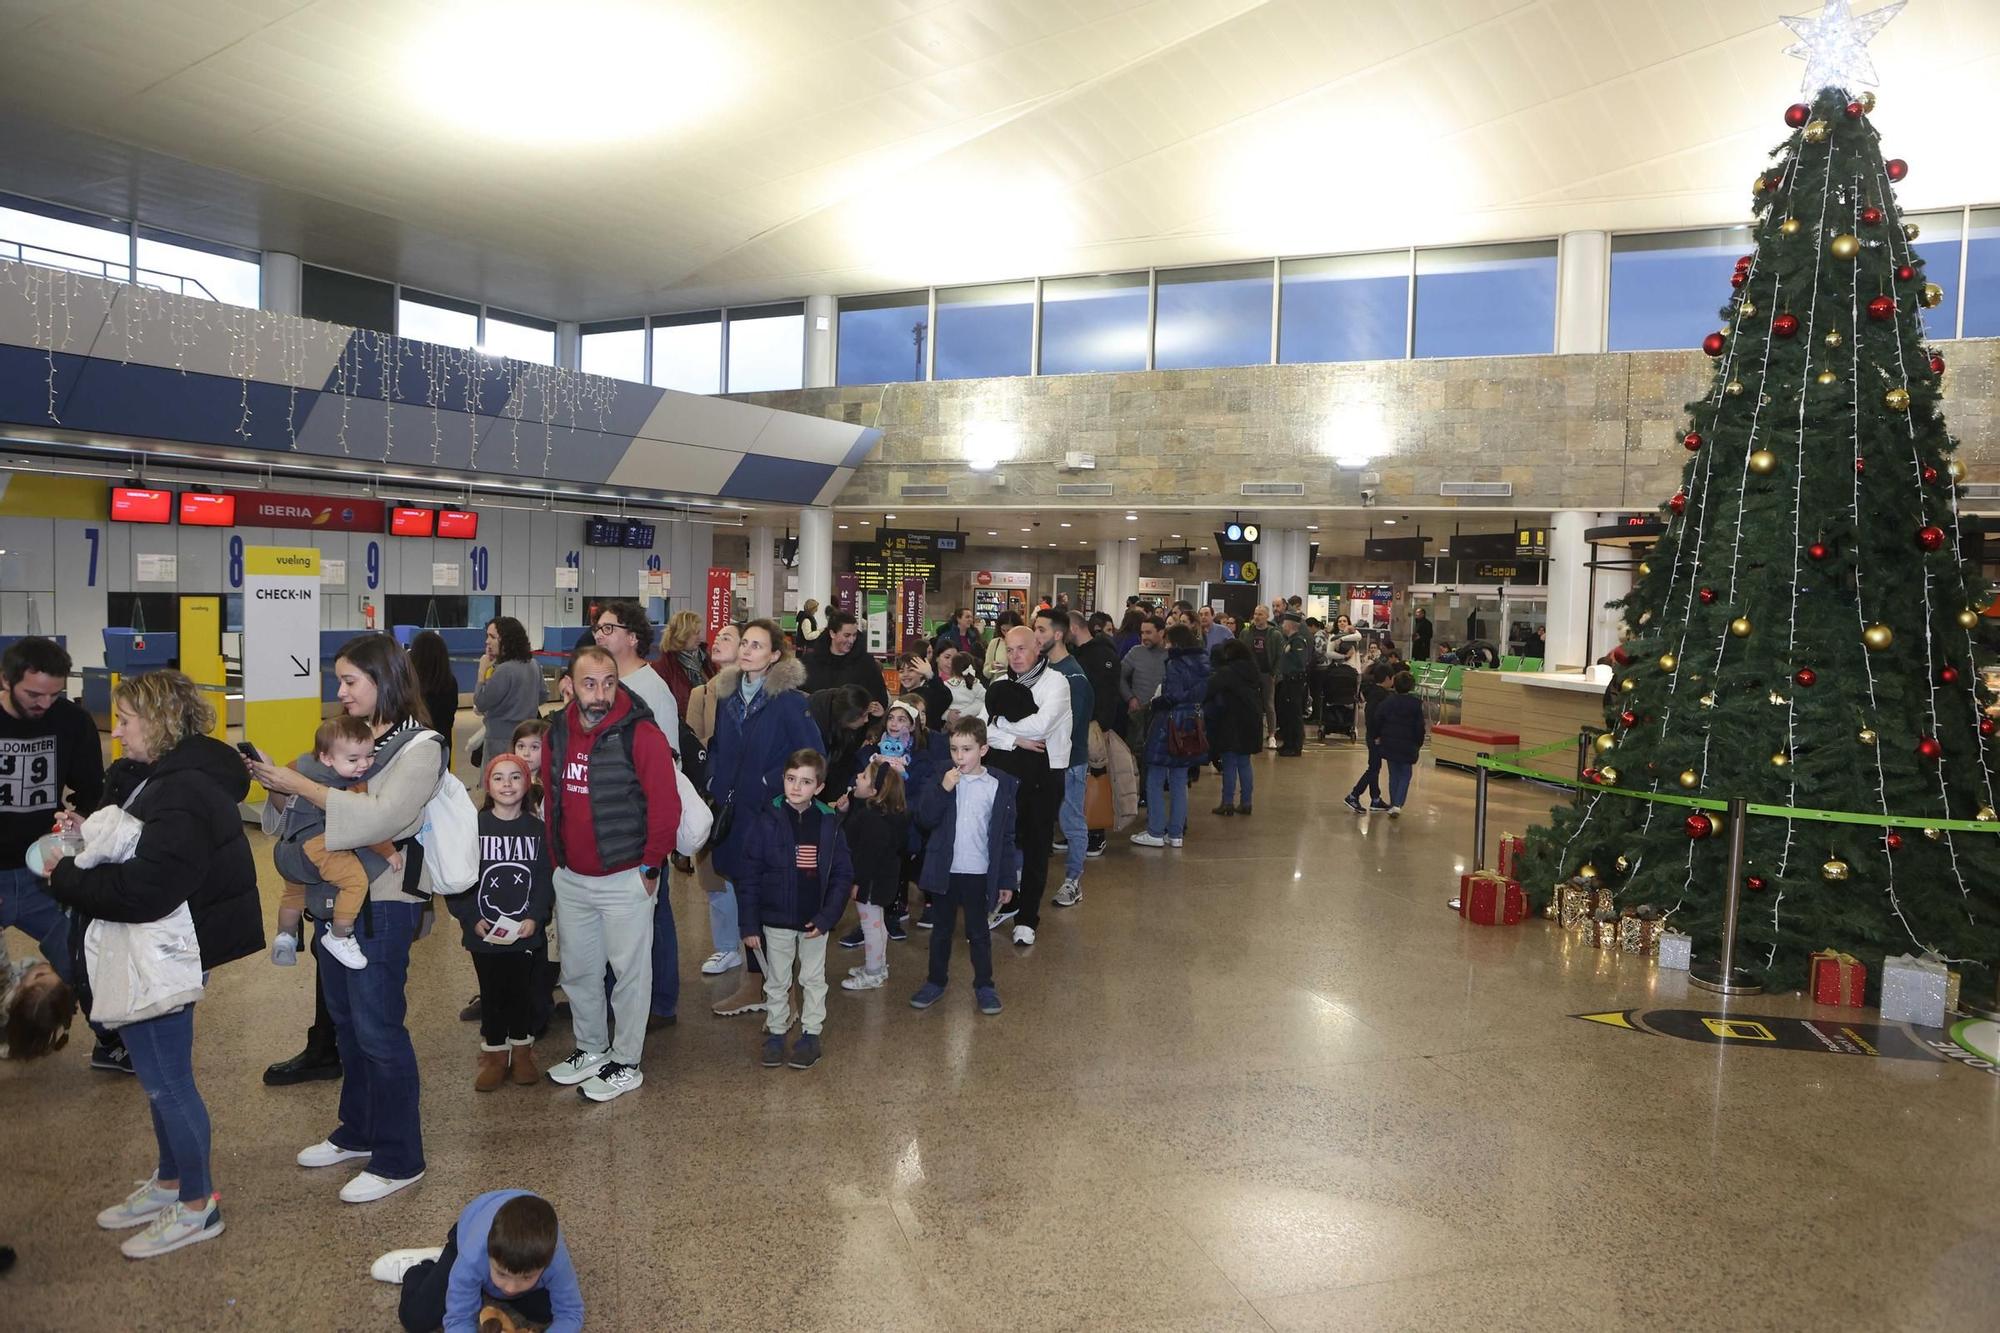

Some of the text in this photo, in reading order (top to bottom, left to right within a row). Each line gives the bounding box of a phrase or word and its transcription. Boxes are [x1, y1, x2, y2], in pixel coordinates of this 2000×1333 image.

[259, 505, 312, 518] IBERIA
[85, 528, 99, 587] 7
[229, 534, 243, 589] 8
[276, 555, 311, 568] vueling
[367, 541, 379, 589] 9
[470, 546, 489, 591] 10
[256, 588, 313, 601] CHECK-IN
[711, 587, 720, 631] Turista
[722, 588, 731, 628] onomy
[906, 590, 915, 635] Business
[4, 740, 54, 753] DOMETER
[30, 756, 48, 784] 9
